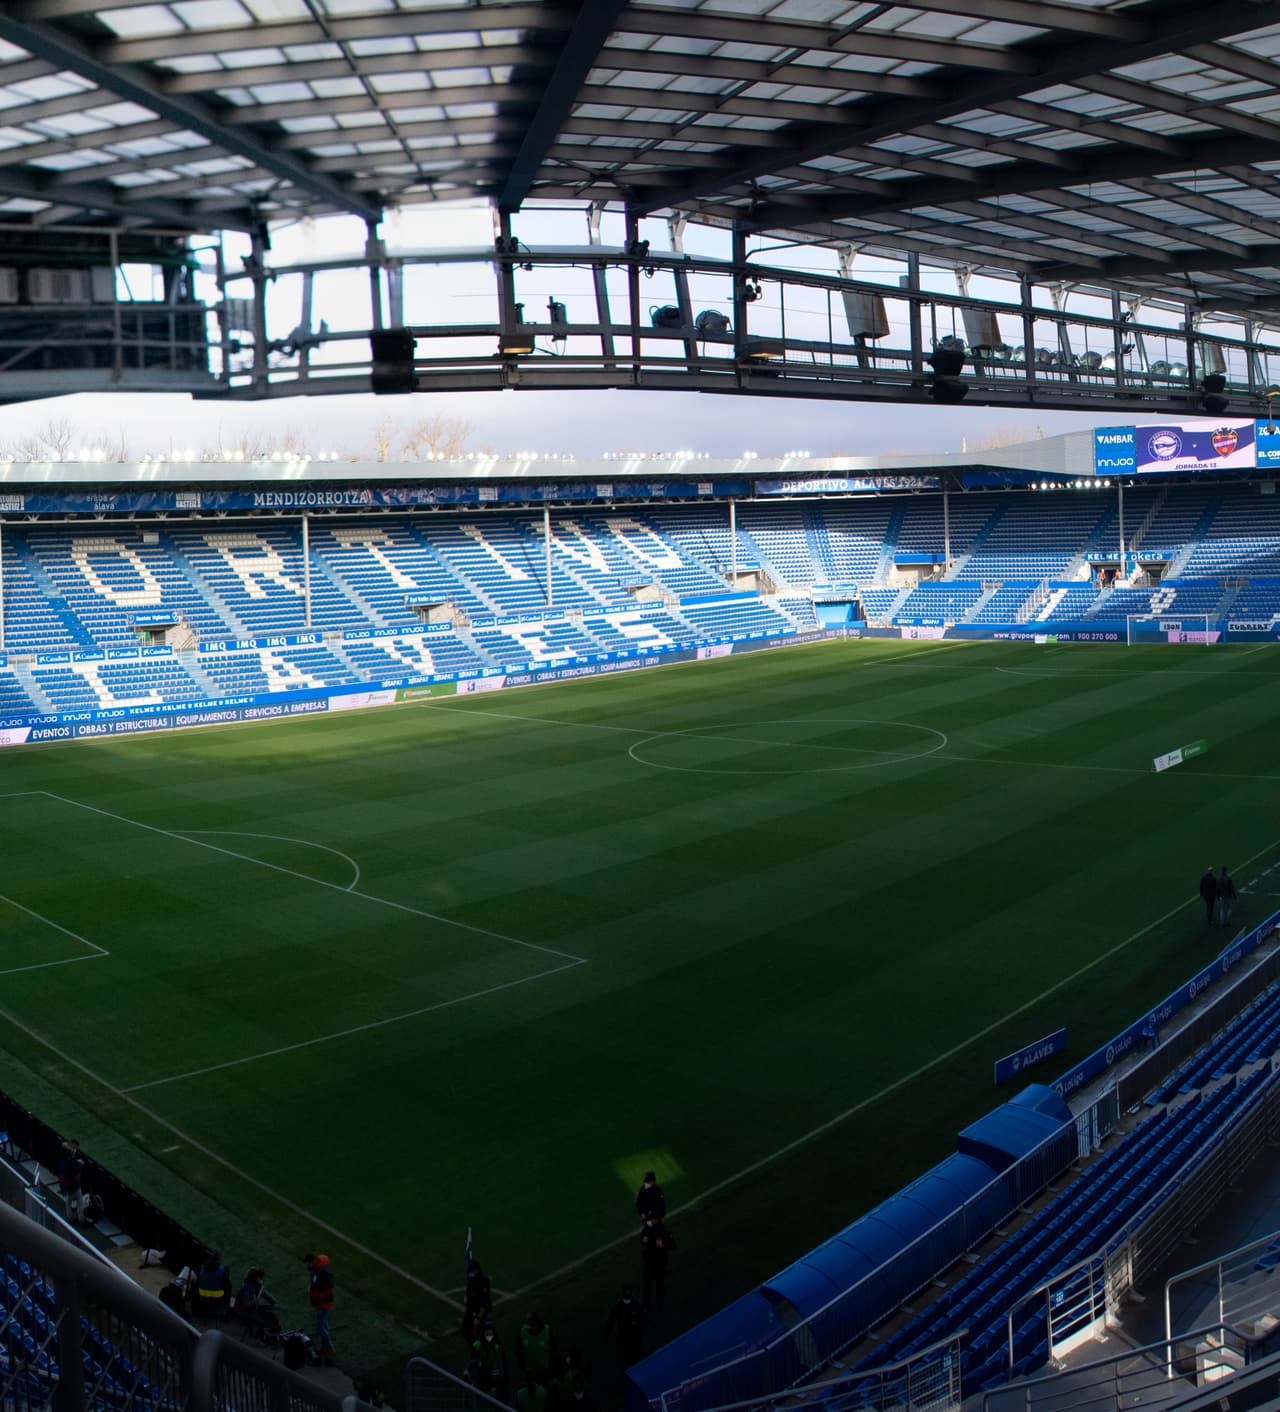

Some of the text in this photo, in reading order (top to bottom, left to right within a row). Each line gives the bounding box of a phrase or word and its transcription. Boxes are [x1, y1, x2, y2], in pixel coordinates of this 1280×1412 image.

[1104, 434, 1133, 444] AMBAR
[782, 479, 848, 491] DEPORTIVO
[254, 490, 368, 506] MENDIZORROTZA
[1131, 552, 1163, 560] oketa
[205, 634, 316, 651] IMQ IMQ IMQ IMQ
[129, 706, 154, 714] KELME
[162, 703, 186, 711] KELME
[224, 698, 248, 706] KELME
[32, 701, 326, 740] EVENTOS OBRAS Y ESTRUCTURAS EQUIPAMIENTOS SERVICIOS A EMPRESAS
